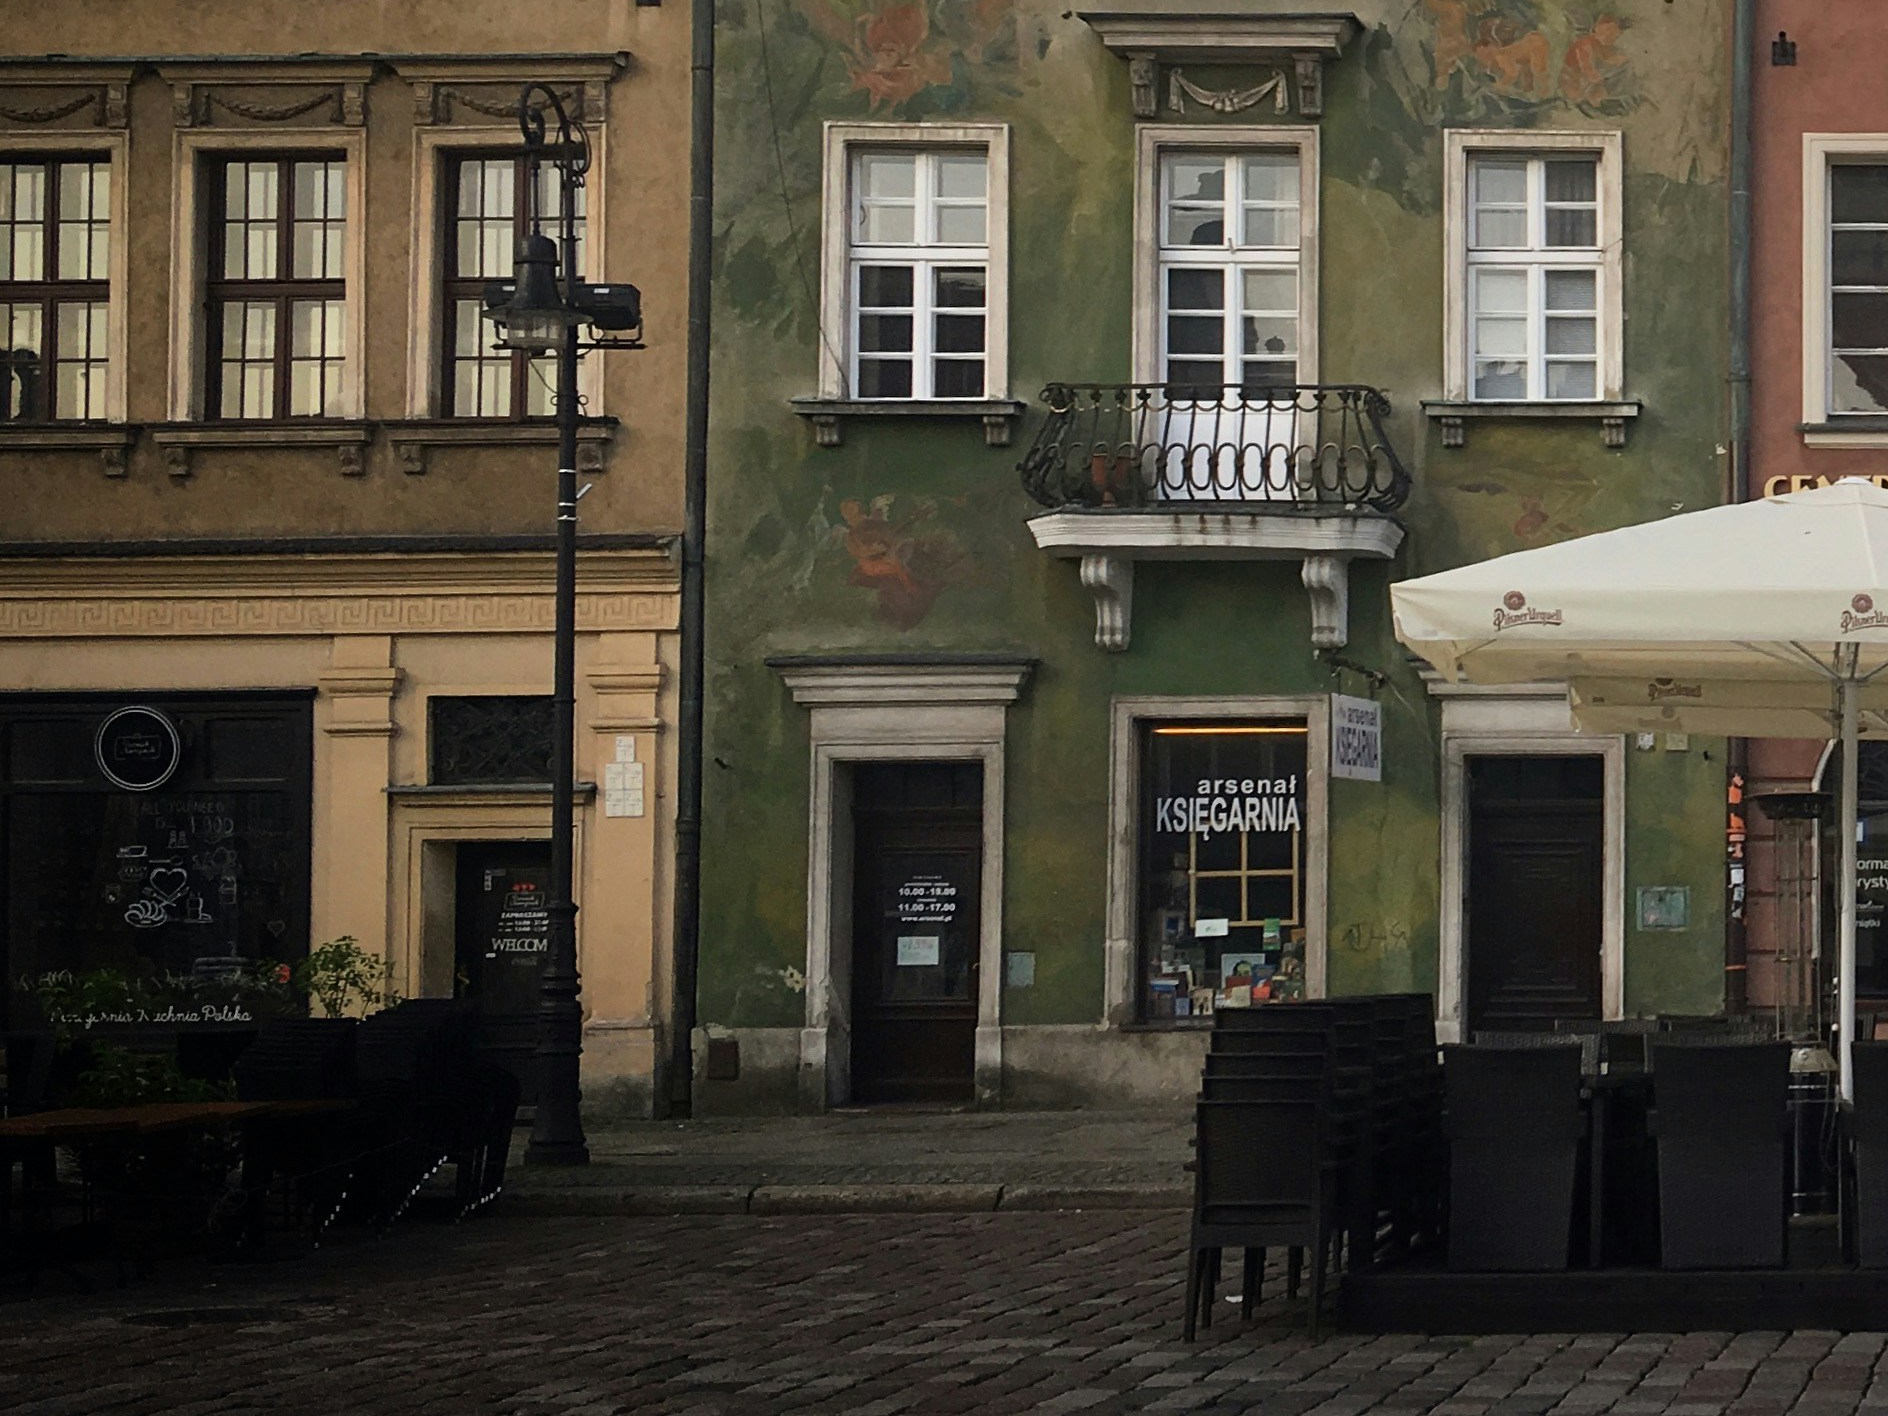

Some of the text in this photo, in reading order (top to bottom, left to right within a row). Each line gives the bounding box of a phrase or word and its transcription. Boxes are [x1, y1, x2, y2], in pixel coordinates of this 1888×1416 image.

[1493, 607, 1563, 632] Pilsner Urquell
[1840, 610, 1875, 634] Pilsner
[1197, 774, 1297, 794] arsenał
[1156, 797, 1301, 842] KSIĘGARNIA
[491, 938, 548, 953] WELCOM
[202, 1005, 253, 1022] Polska
